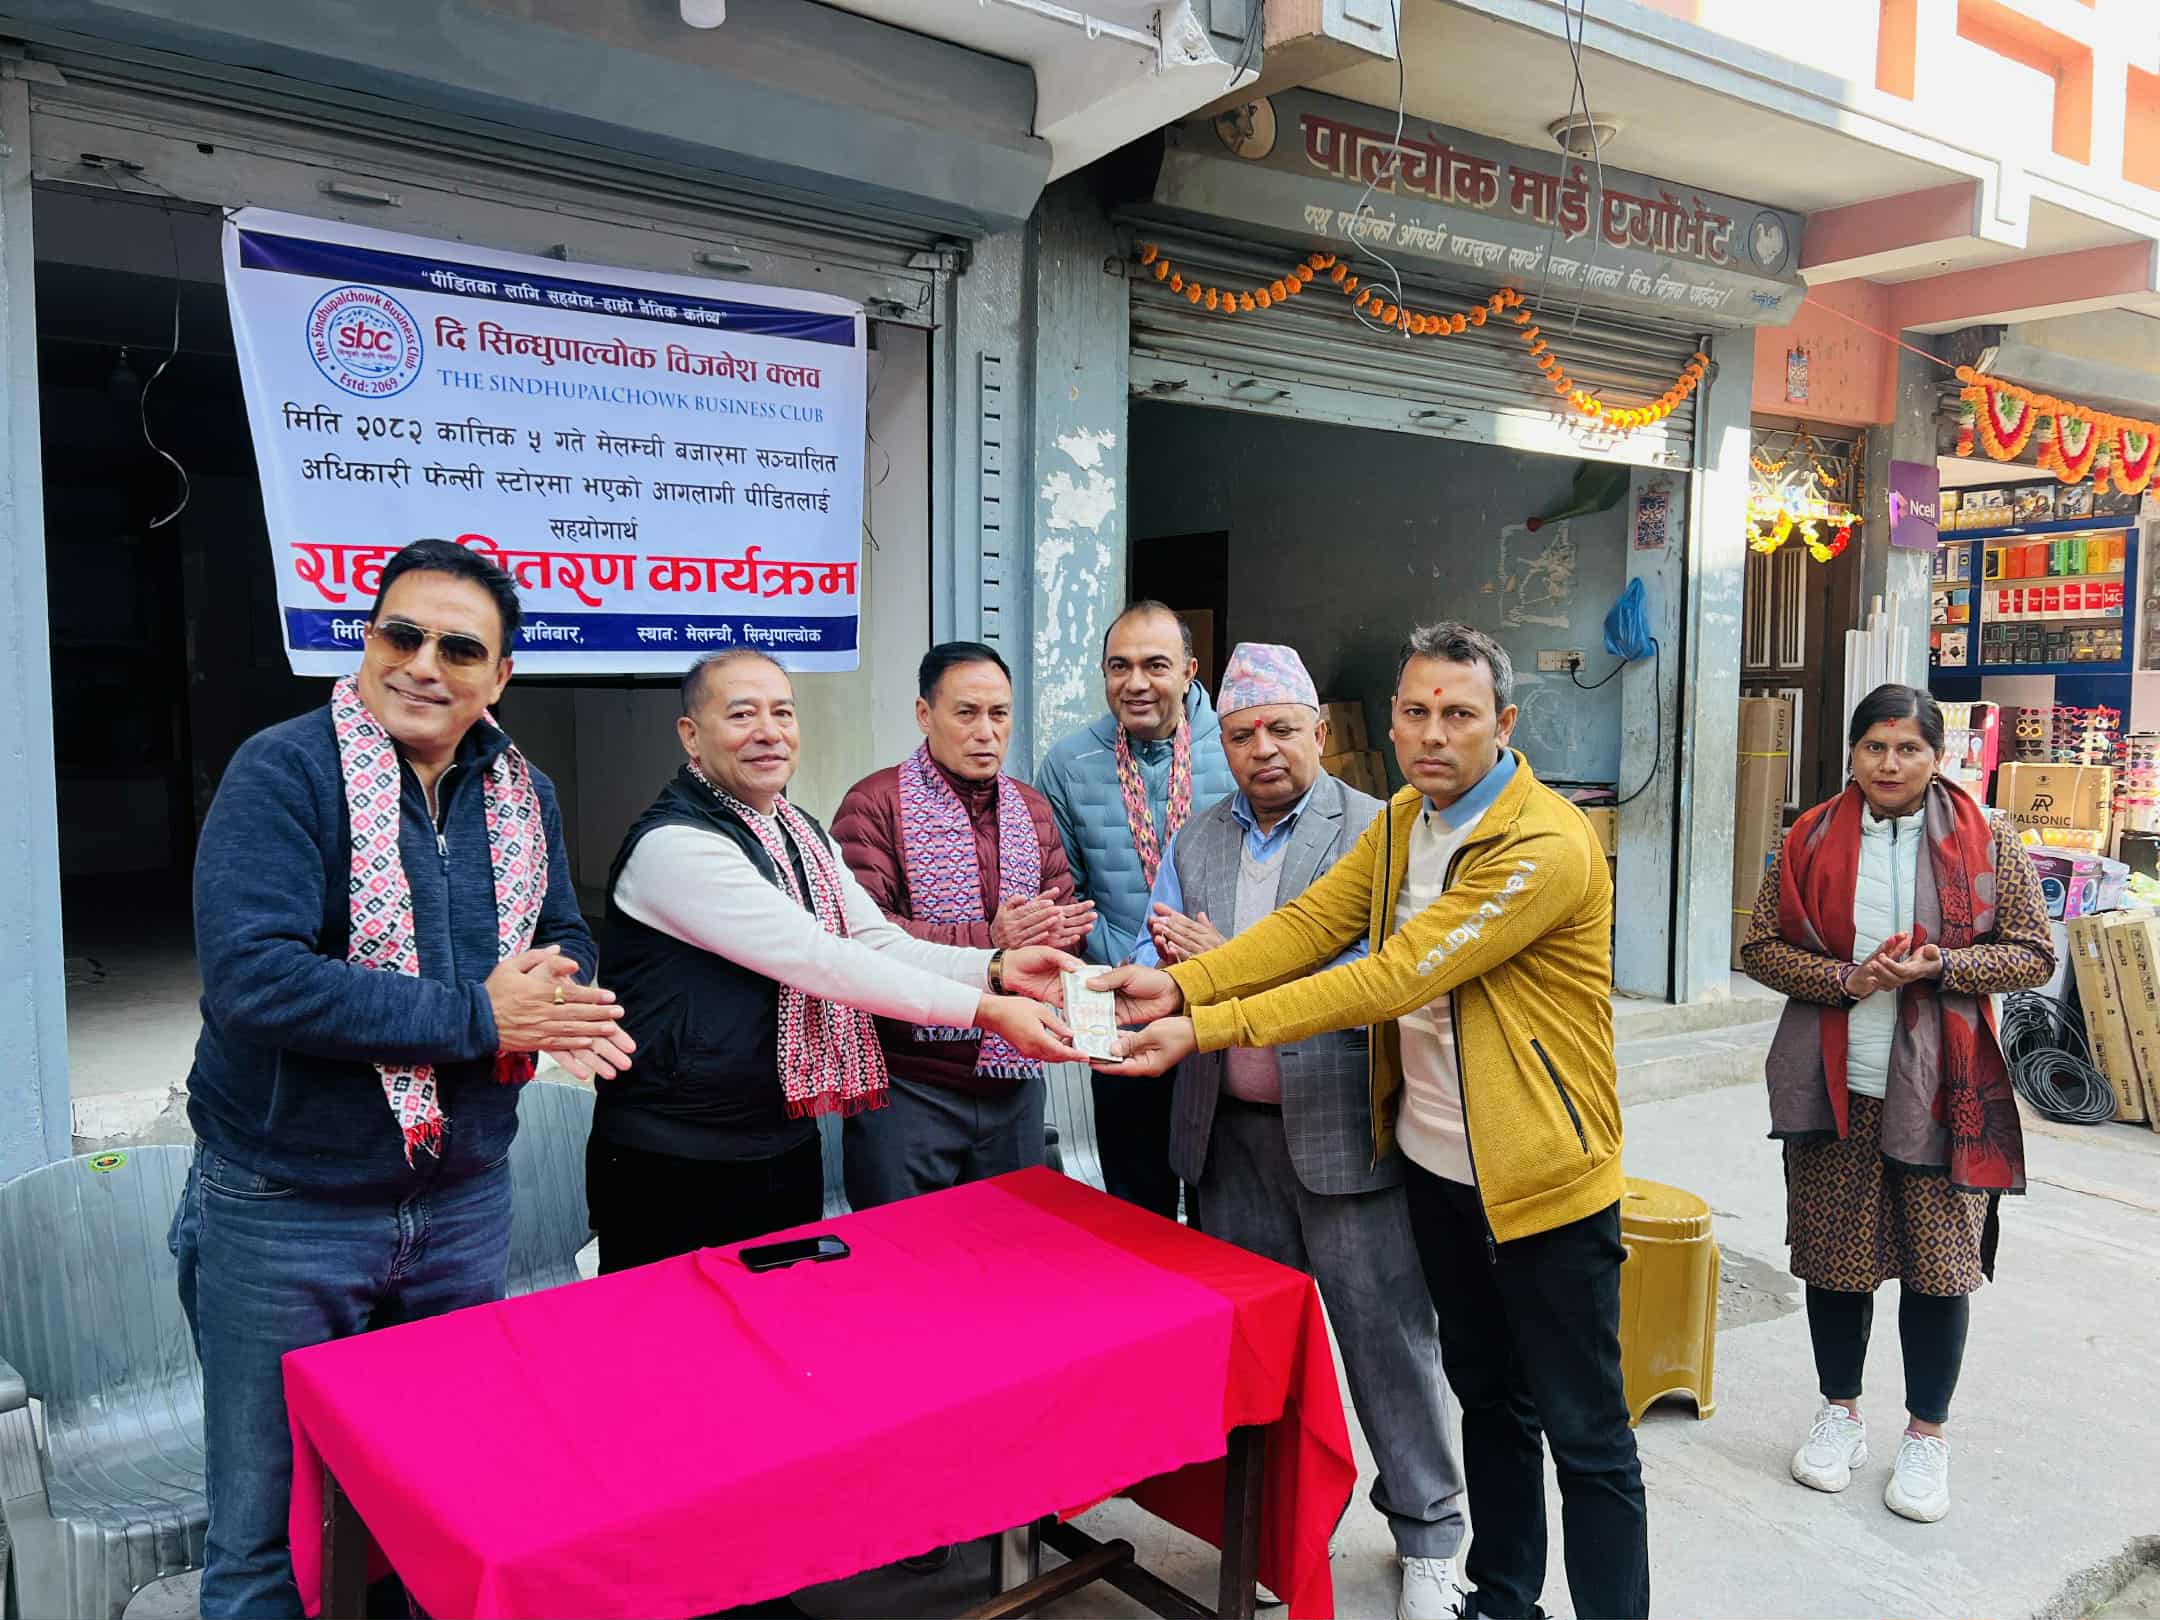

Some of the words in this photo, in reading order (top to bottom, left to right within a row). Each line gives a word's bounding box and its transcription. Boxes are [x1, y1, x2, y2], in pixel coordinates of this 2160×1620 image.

[1508, 165, 1592, 243] माई
[503, 282, 541, 301] लागि
[311, 290, 382, 338] Sindhupalchowk
[383, 299, 416, 345] Business
[315, 340, 330, 363] The
[338, 320, 394, 352] sbc
[434, 316, 468, 351] दि
[478, 321, 658, 369] सिन्धुपाल्चोक
[404, 346, 420, 370] Club
[371, 377, 398, 393] 2069
[436, 368, 486, 390] THE
[490, 374, 691, 410] SINDHUPALCHOWK
[695, 395, 777, 418] BUSINESS
[780, 403, 825, 423] CLUB
[281, 401, 343, 434] मिति
[356, 415, 424, 445] २०८२
[528, 429, 542, 453] ५
[554, 427, 586, 454] गते
[596, 429, 665, 459] मेलम्ची
[674, 441, 747, 467] बजारमा
[756, 447, 839, 473] सञ्चालित
[301, 452, 412, 489] अधिकारी
[423, 461, 485, 491] फेन्सी
[496, 467, 572, 497] स्टोरमा
[583, 474, 643, 502] भएको
[653, 480, 736, 505] आगलागी
[744, 482, 831, 514] पीडितलाई
[1910, 499, 1936, 519] Ncell
[549, 515, 639, 543] सहयोगार्थ
[290, 542, 404, 603] राह
[646, 545, 858, 598] कार्यक्रम
[742, 623, 822, 647] सिन्धुपाल्चोक
